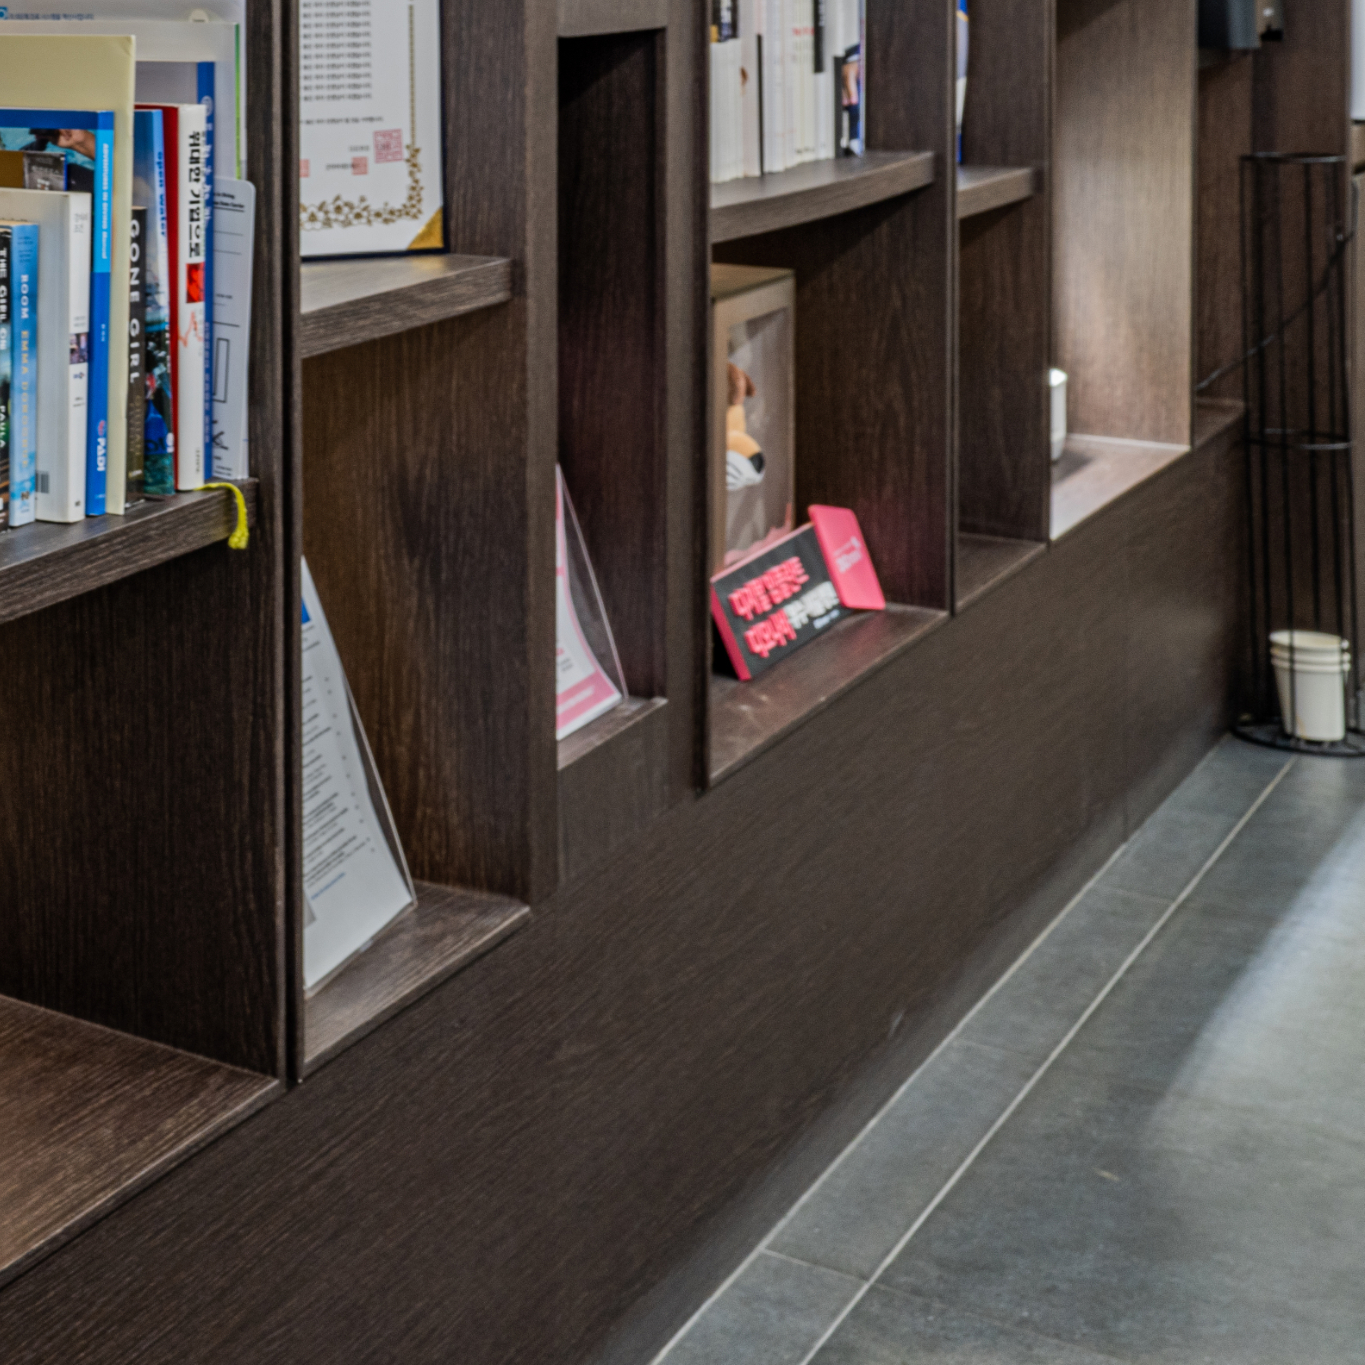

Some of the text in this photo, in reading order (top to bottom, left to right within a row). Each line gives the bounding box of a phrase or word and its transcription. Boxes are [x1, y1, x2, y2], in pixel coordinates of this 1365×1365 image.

[189, 189, 201, 258] 기업으로
[0, 247, 8, 279] THE
[129, 220, 140, 302] GONE
[0, 284, 8, 324] GIRL
[21, 274, 29, 375] ROOM EMMA
[0, 327, 8, 350] ON
[129, 318, 140, 384] GIRL
